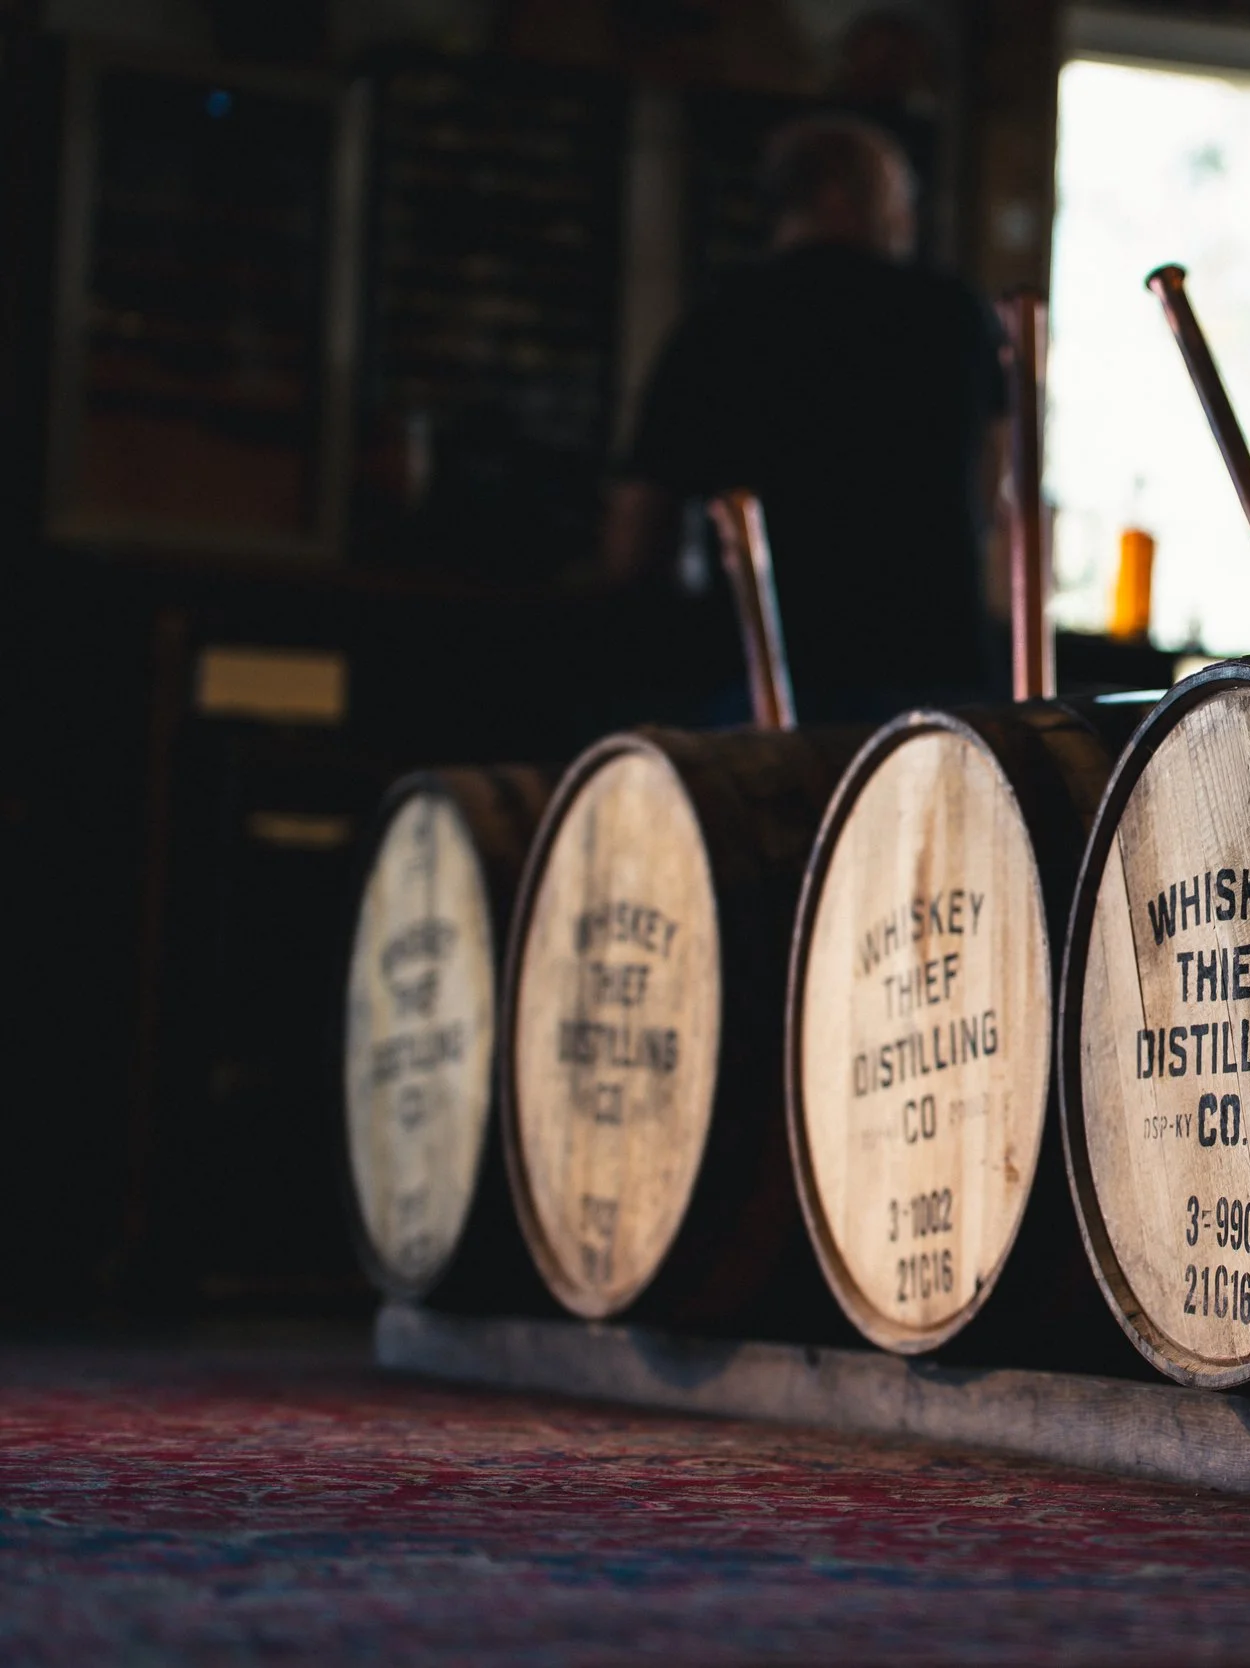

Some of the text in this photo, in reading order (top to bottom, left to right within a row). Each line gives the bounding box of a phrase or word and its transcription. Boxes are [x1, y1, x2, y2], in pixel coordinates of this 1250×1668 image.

[859, 888, 985, 976] WHISKEY
[883, 953, 960, 1020] THIEF
[853, 1009, 999, 1098] DISTILLING
[1143, 1113, 1193, 1140] DSP-KY
[1198, 1092, 1248, 1148] CO.
